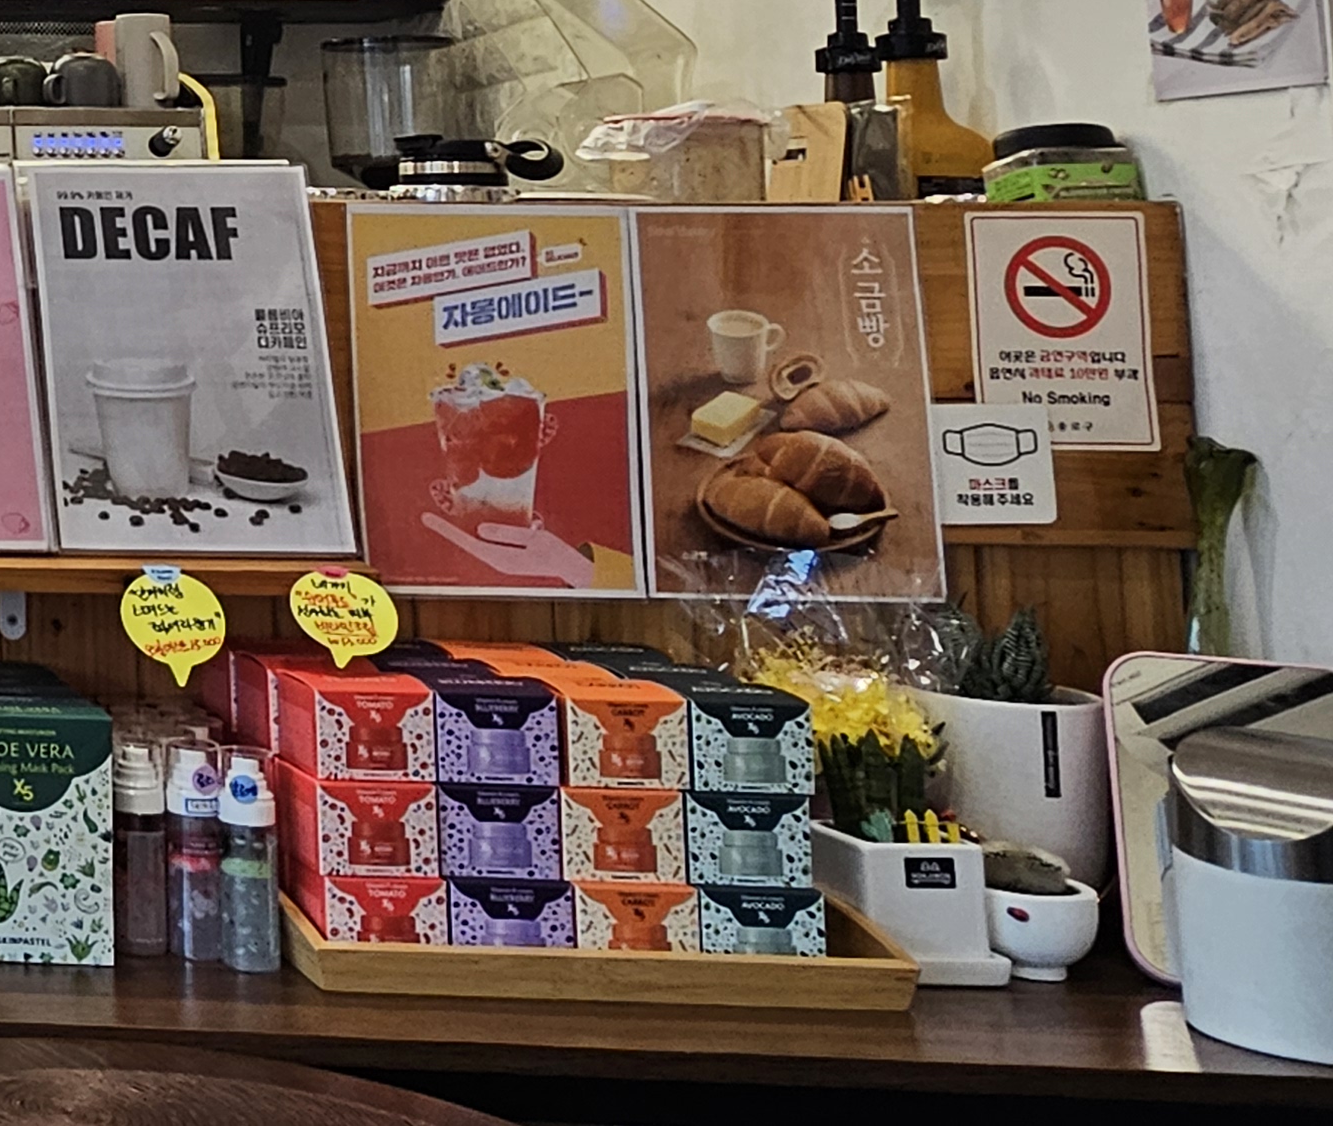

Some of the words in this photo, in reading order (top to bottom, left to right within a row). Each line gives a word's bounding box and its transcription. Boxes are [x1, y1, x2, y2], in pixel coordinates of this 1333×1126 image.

[58, 205, 239, 262] DECAF
[372, 259, 423, 279] 지금까지
[425, 253, 451, 269] 이런
[851, 247, 887, 349] 소금빵
[999, 349, 1037, 364] 이곳은
[1069, 367, 1109, 381] 10만원
[1022, 391, 1043, 405] No
[1047, 391, 1111, 407] Smoking
[968, 478, 1019, 491] 마스크를
[997, 493, 1034, 507] 주세요
[355, 700, 394, 710] TOMATO
[730, 712, 774, 722] AVOCADO
[24, 743, 75, 760] VERA
[20, 762, 49, 774] Mask
[51, 763, 75, 775] Pack
[358, 795, 397, 805] TOMATO
[726, 805, 771, 815] AVOCADO
[367, 889, 407, 899] TOMATO
[740, 901, 785, 911] AVOCADO
